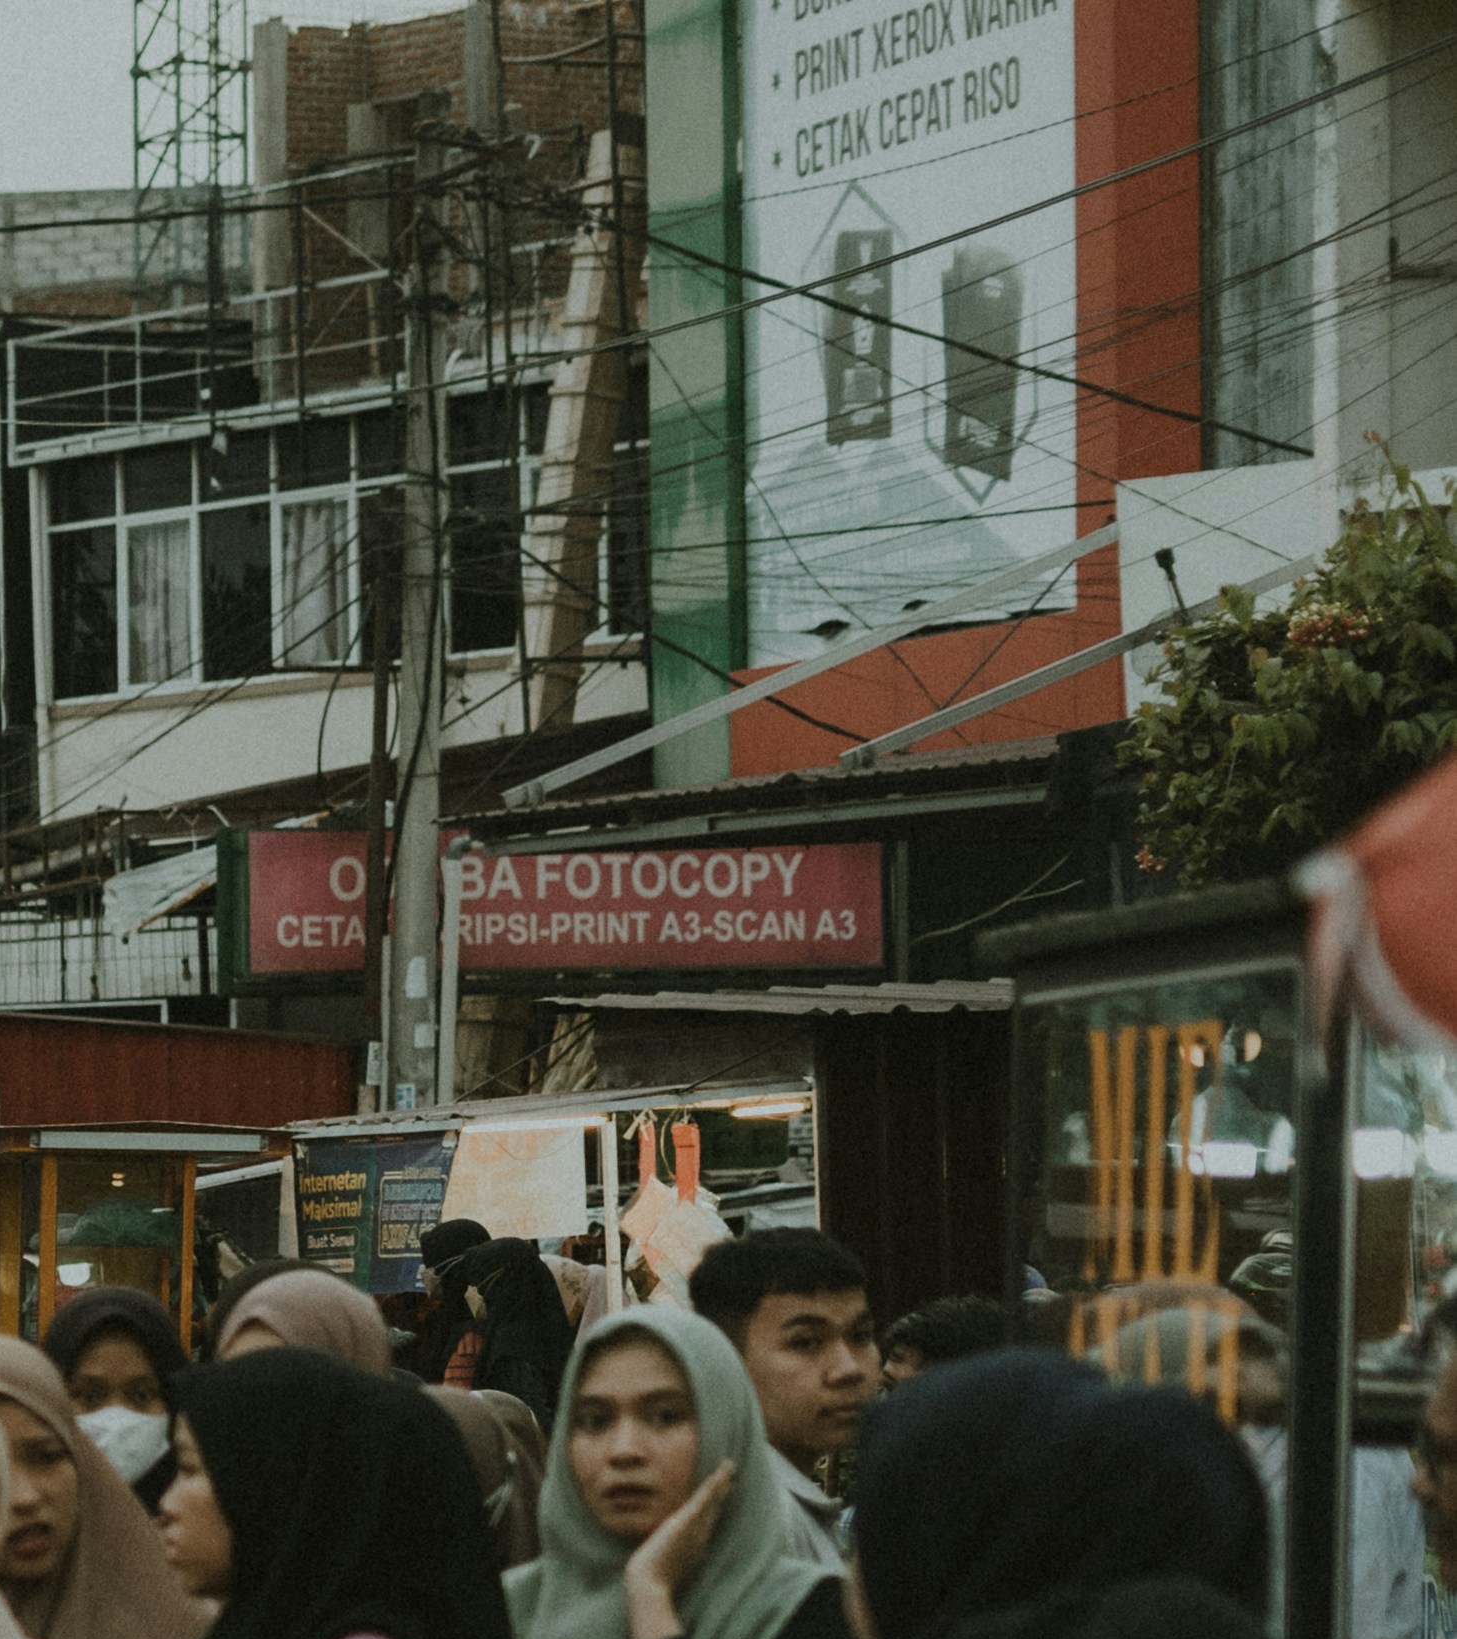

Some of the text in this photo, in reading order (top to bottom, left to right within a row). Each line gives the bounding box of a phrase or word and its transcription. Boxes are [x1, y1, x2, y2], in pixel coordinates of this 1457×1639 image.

[794, 0, 1058, 101] PRINT XEROX WAR
[795, 56, 1021, 178] CETAK CEPAT RISO
[536, 853, 804, 899] FOTOCOPY
[276, 914, 366, 947] CETA
[658, 910, 806, 942] A3-SCAN
[814, 909, 858, 941] A3
[299, 1170, 368, 1194] Internetan
[302, 1195, 363, 1223] Maksimal
